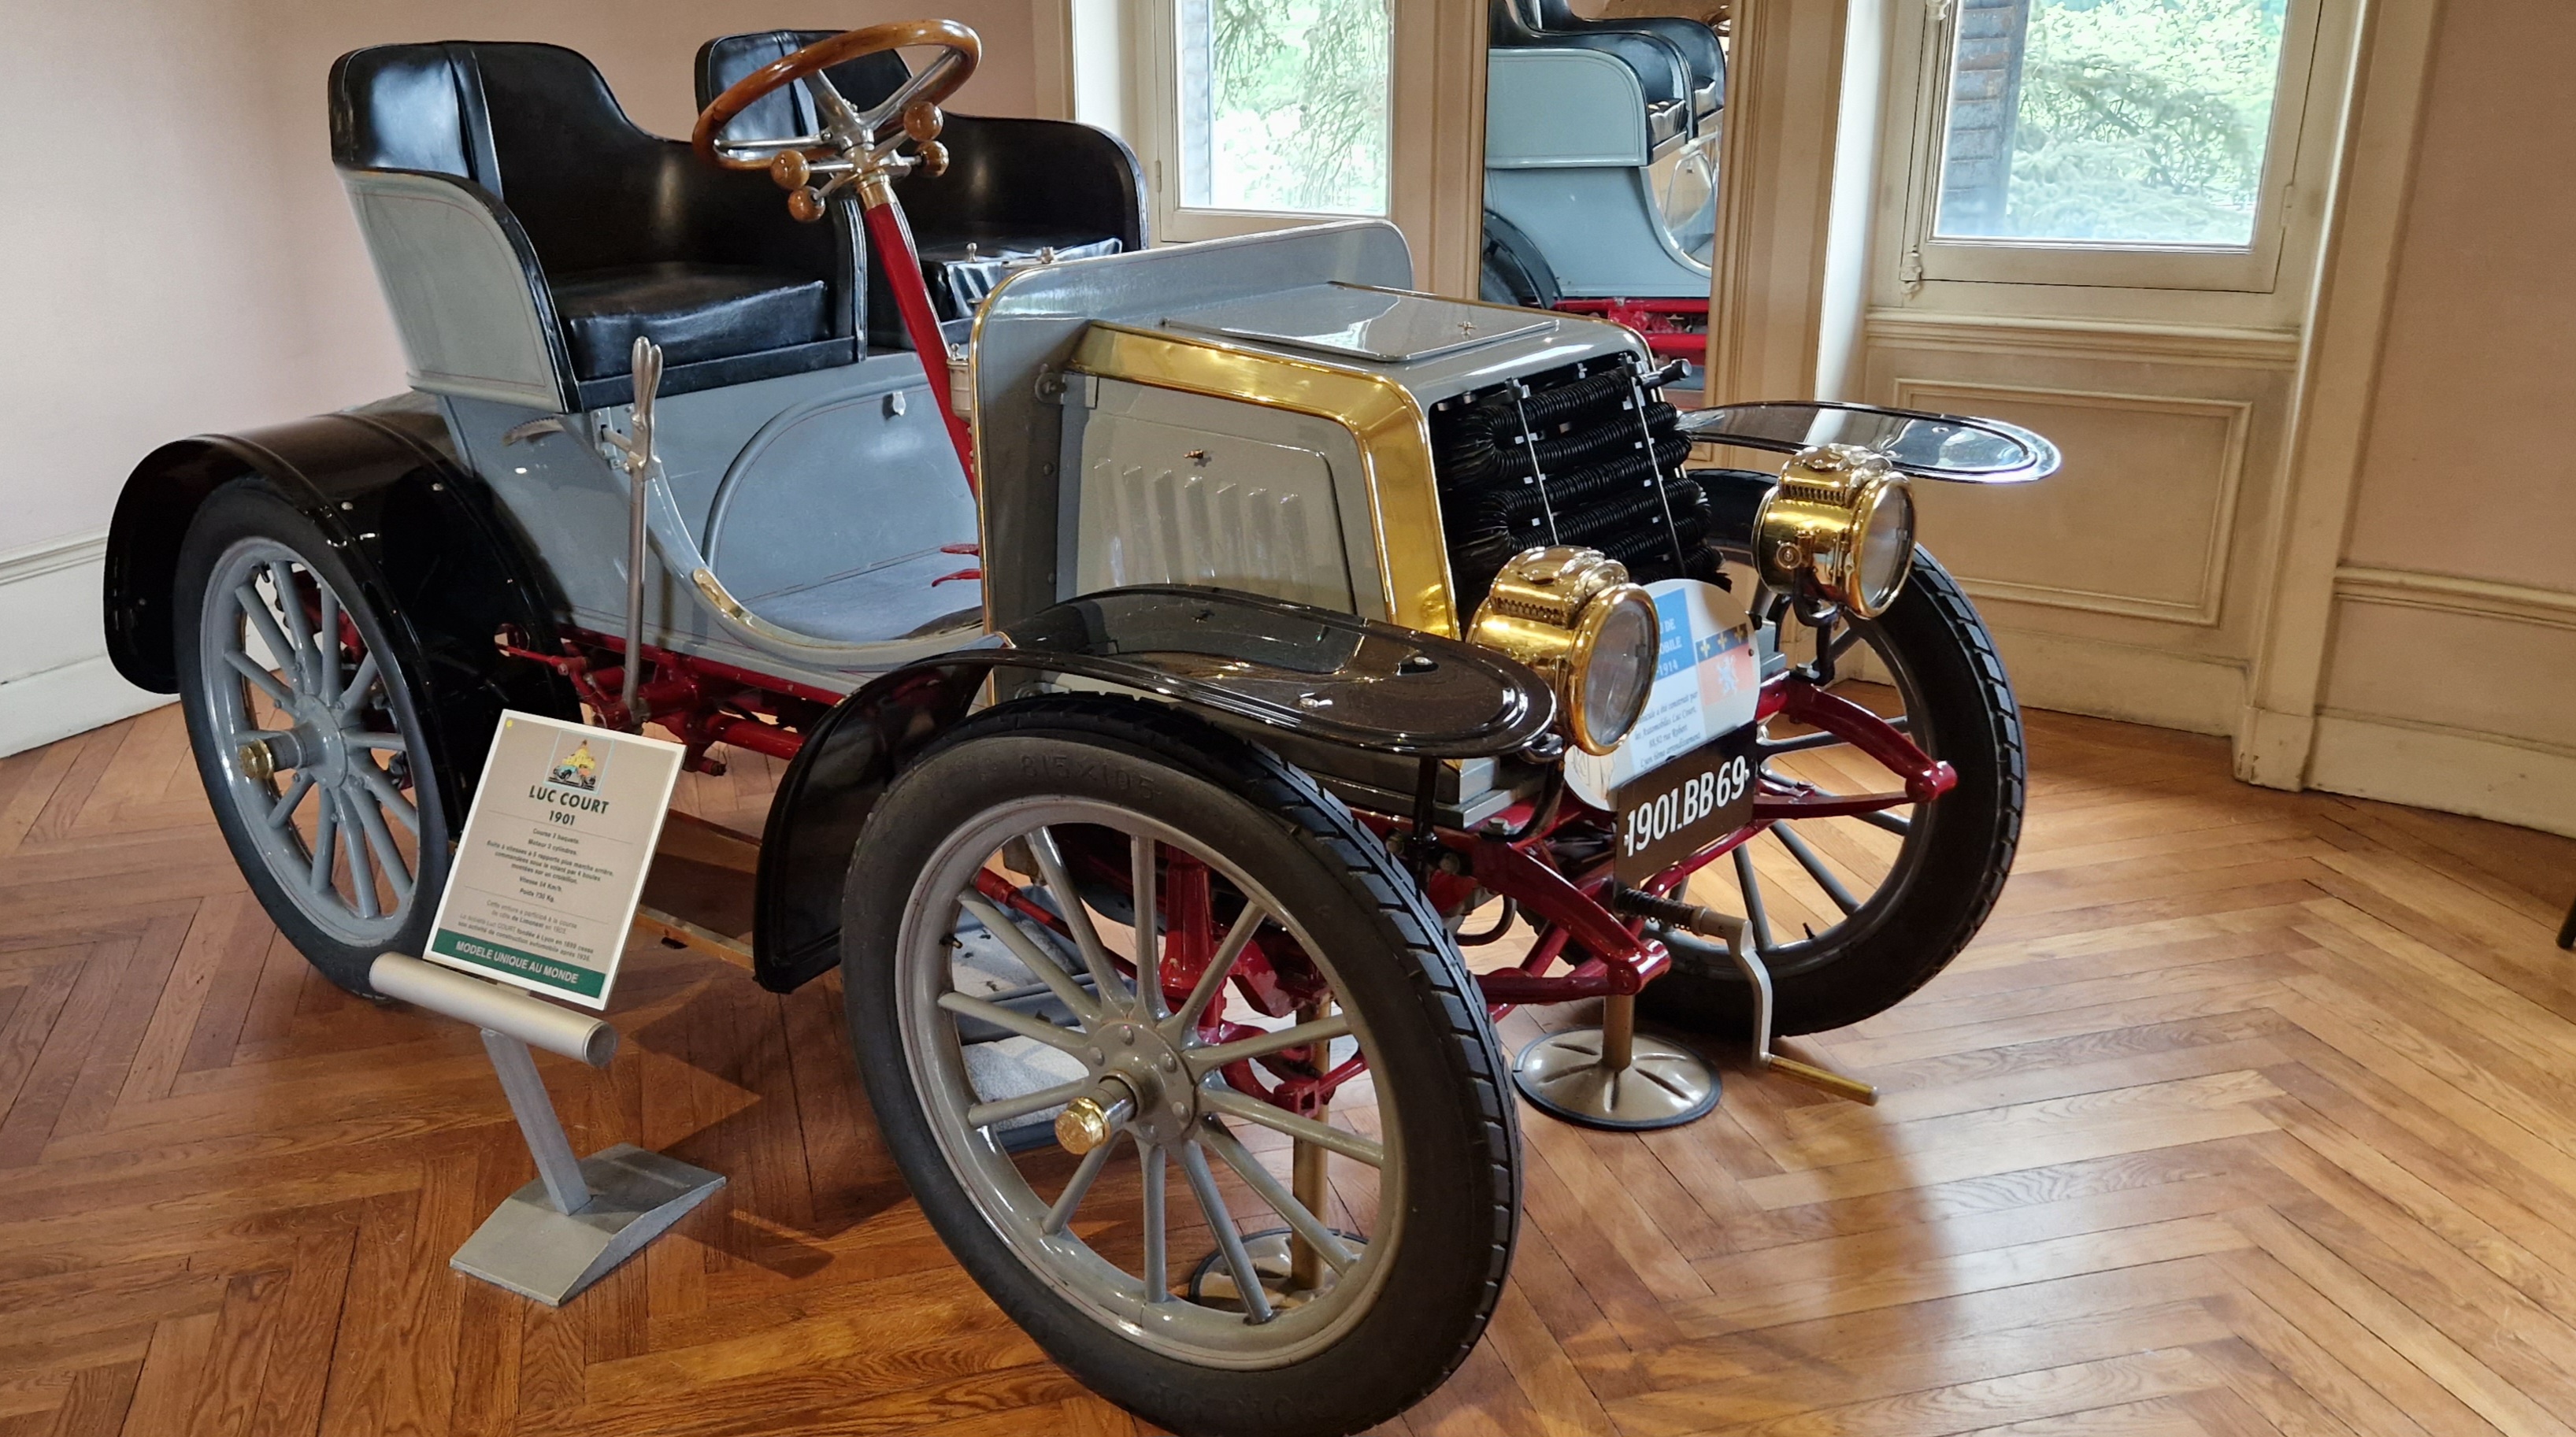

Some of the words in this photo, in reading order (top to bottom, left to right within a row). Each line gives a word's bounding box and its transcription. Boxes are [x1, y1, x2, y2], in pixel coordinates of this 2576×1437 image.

[1665, 618, 1676, 632] DE
[1672, 713, 1681, 722] Luc
[528, 785, 557, 802] LUC
[560, 792, 610, 814] COURT
[549, 810, 576, 825] 1901
[533, 828, 551, 837] Course
[528, 839, 547, 848] Moteur
[506, 845, 527, 854] vitesses
[537, 852, 560, 864] rapports
[561, 858, 573, 867] plus
[573, 861, 594, 871] marche
[495, 850, 528, 863] commandées
[550, 864, 566, 872] volant
[567, 868, 577, 876] par
[582, 872, 601, 881] boules
[511, 862, 534, 873] montées
[519, 876, 538, 886] Vitesse
[520, 887, 535, 896] Poids
[486, 899, 500, 908] Cette
[502, 903, 519, 913] voiture
[524, 909, 547, 921] participé
[559, 918, 577, 928] course
[520, 917, 544, 928] Limonest
[469, 923, 487, 933] activité
[496, 931, 528, 944] construction
[529, 939, 558, 953] automobile
[560, 948, 576, 957] après
[497, 923, 516, 932] COURT
[517, 928, 535, 938] fondée
[541, 935, 554, 944] Lyon
[578, 944, 594, 954] cessa
[456, 940, 492, 959] MODELE
[494, 950, 528, 969] UNIQUE
[528, 961, 543, 973] AU
[543, 965, 579, 983] MONDE
